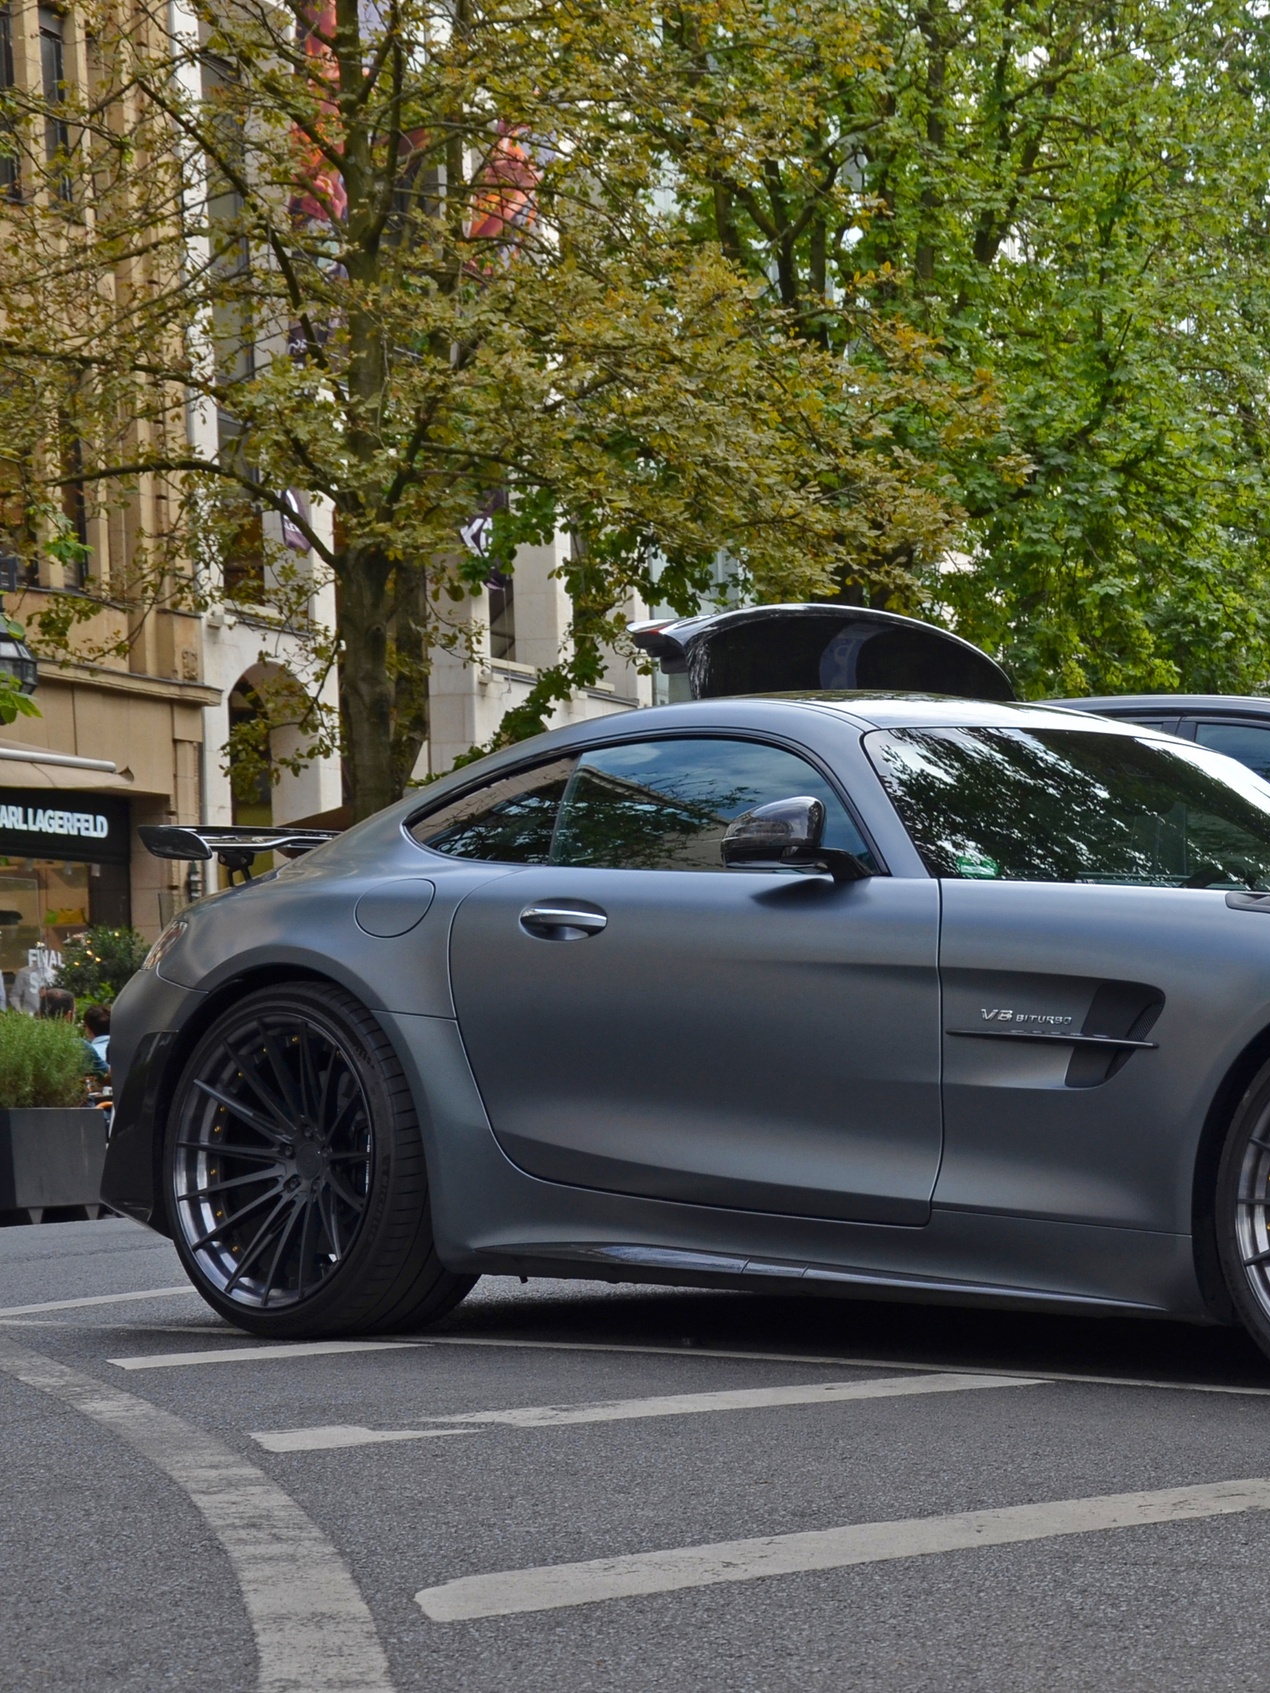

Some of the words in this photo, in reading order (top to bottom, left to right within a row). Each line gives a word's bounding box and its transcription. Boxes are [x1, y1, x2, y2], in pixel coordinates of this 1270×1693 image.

[0, 805, 27, 831] ARL
[27, 807, 108, 838] LAGERFELD
[28, 949, 66, 969] FINAL
[981, 1008, 1013, 1021] V8
[1016, 1014, 1072, 1025] BITURBO
